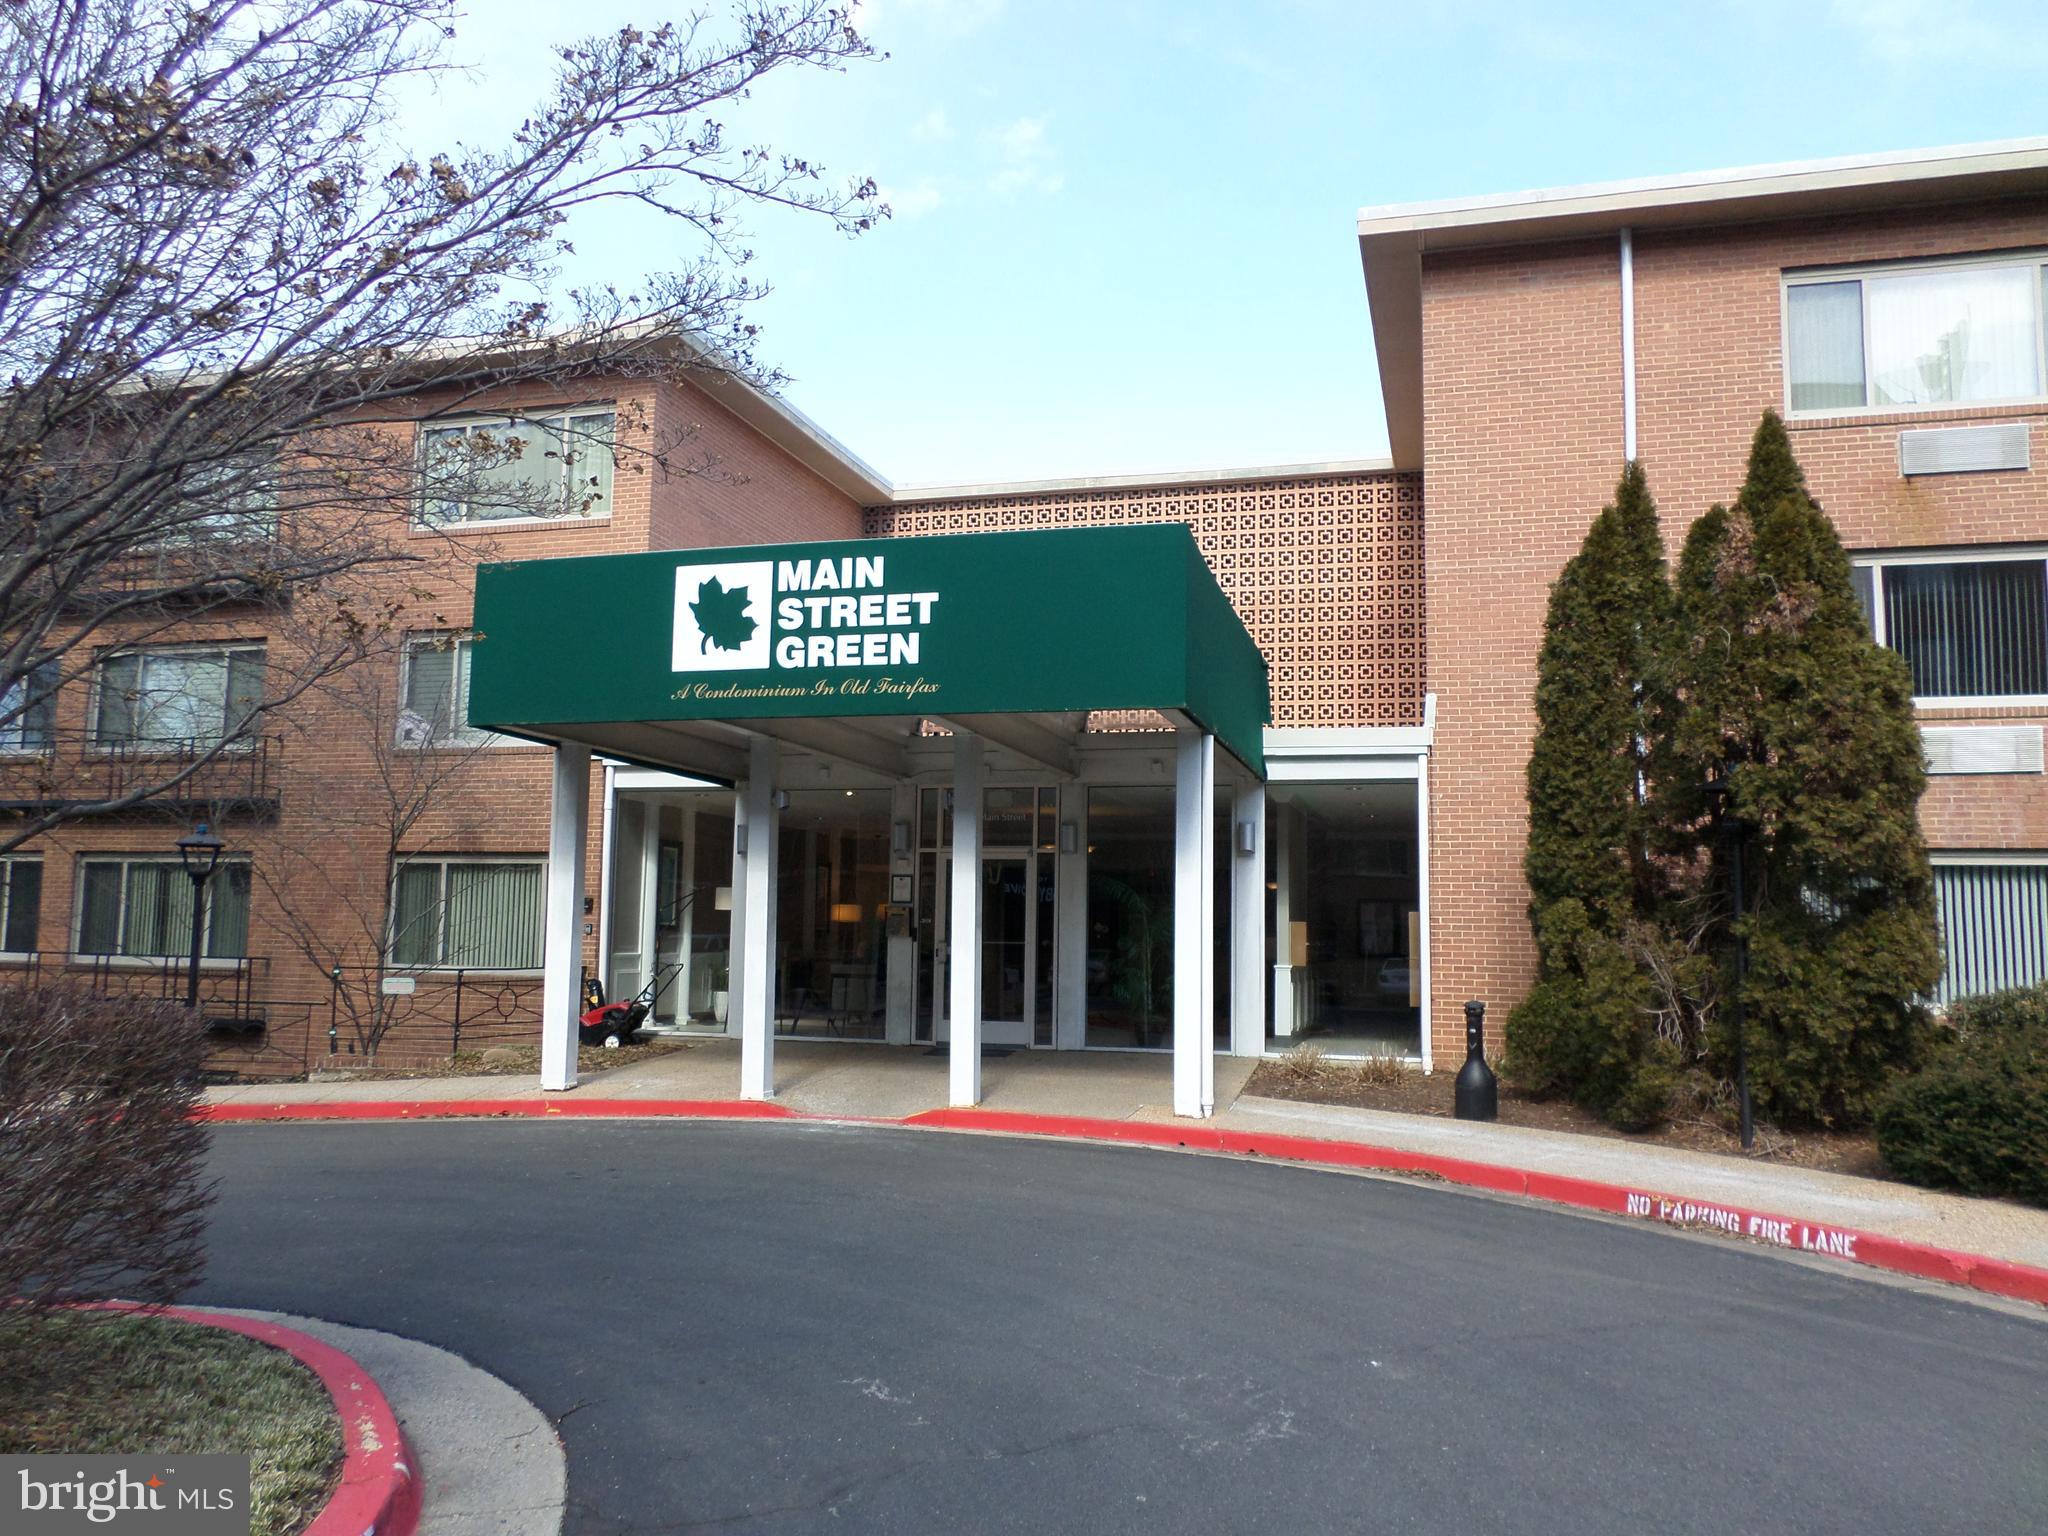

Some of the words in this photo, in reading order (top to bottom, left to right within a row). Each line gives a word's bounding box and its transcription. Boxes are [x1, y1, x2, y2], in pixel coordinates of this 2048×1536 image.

[777, 556, 885, 592] MAIN
[777, 592, 940, 630] STREET
[775, 632, 921, 669] GREEN
[671, 684, 689, 700] A
[693, 682, 808, 700] Condominium
[810, 678, 837, 696] In
[839, 677, 869, 695] Old
[874, 676, 941, 700] Fairfax
[1627, 1193, 1651, 1216] NO
[1660, 1199, 1740, 1232] PARKING
[1750, 1216, 1792, 1245] FIRE
[1802, 1226, 1857, 1258] LANE
